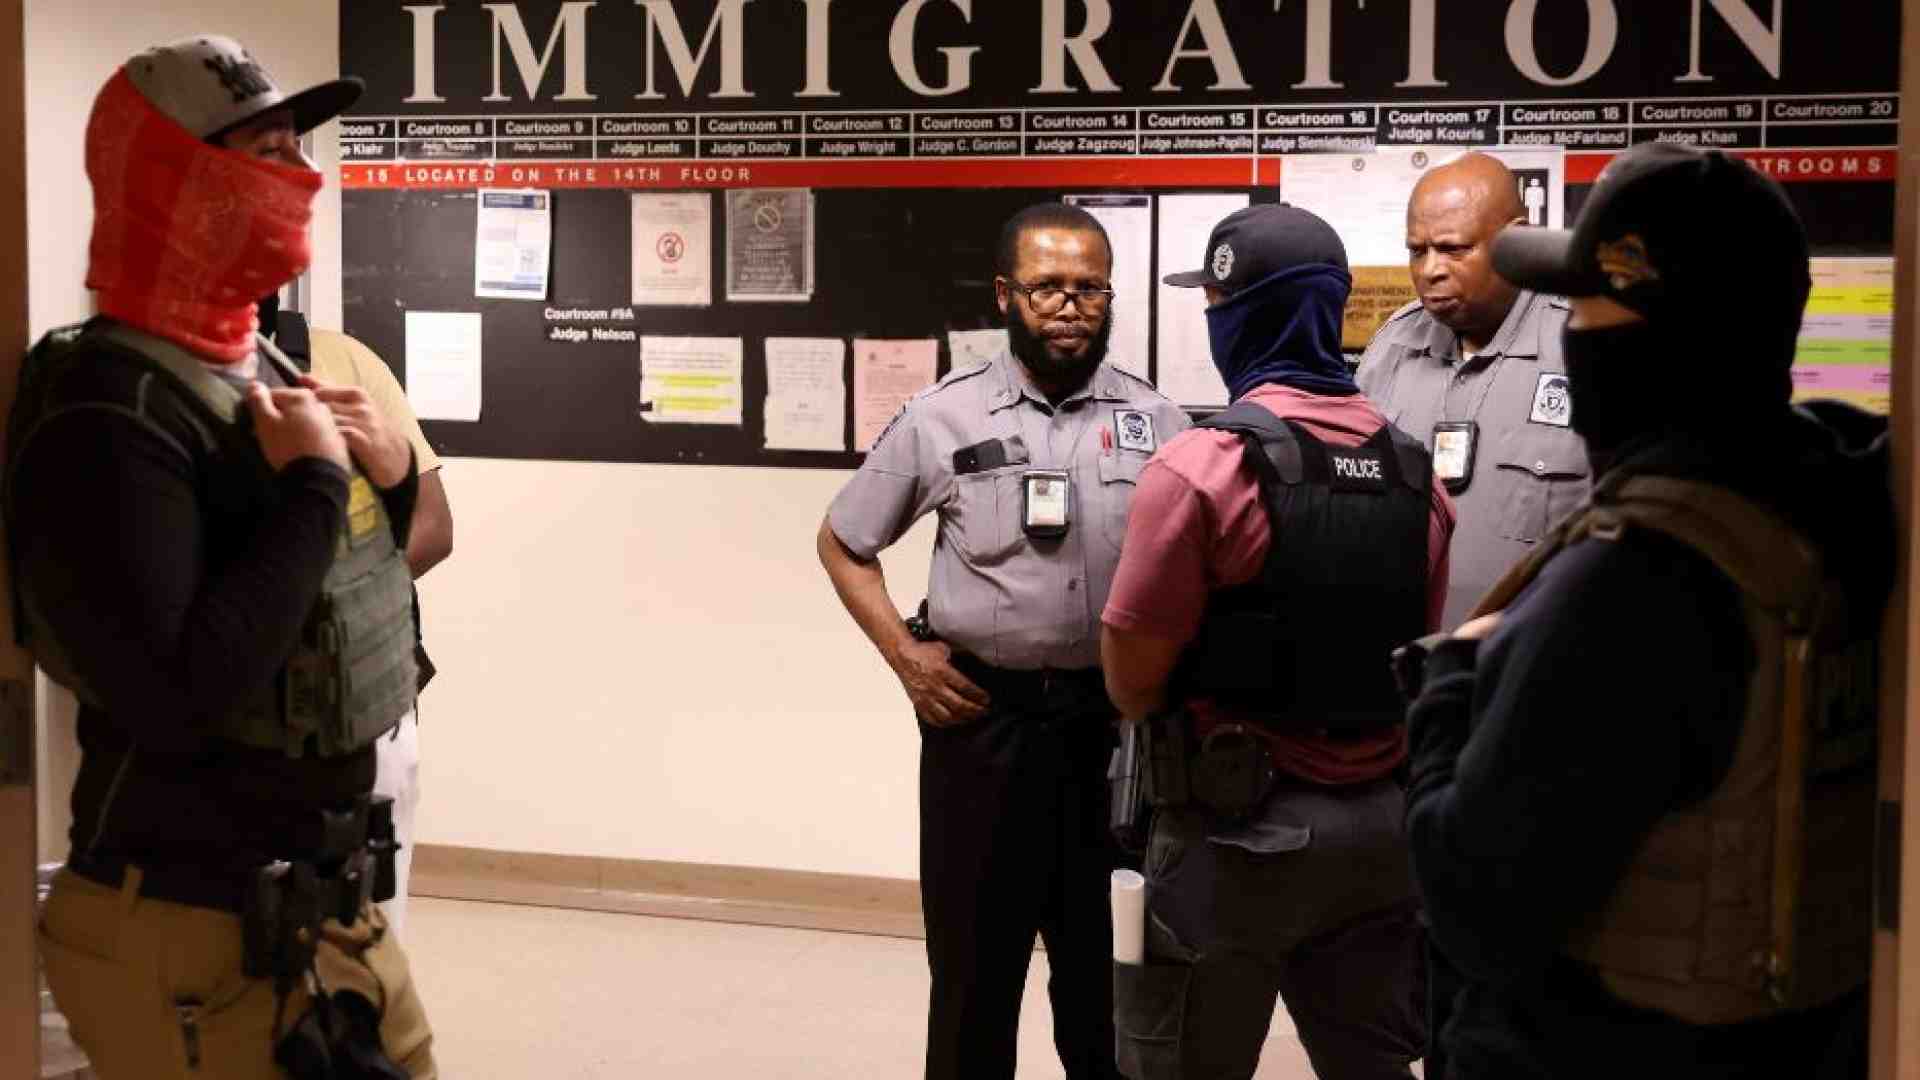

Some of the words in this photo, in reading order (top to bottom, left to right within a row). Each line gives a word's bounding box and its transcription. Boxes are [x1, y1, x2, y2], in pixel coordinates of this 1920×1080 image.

[402, 0, 1785, 105] IMMIGRATION
[1388, 110, 1470, 124] Courtroom
[1475, 108, 1492, 122] 17
[1512, 108, 1597, 122] Courtroom
[1602, 106, 1621, 121] 18
[1641, 105, 1728, 120] Courtroom
[1735, 104, 1753, 119] 19
[1773, 102, 1864, 117] Courtroom
[1869, 100, 1892, 115] 20
[603, 120, 670, 133] Courtroom
[674, 119, 689, 132] 10
[708, 119, 776, 132] Courtroom
[783, 119, 793, 131] 11
[812, 118, 884, 131] Courtroom
[888, 118, 903, 131] 12
[921, 116, 993, 130] Courtroom
[999, 115, 1015, 129] 13
[1032, 115, 1107, 129] Courtroom
[1112, 114, 1128, 127] 14
[1147, 113, 1224, 127] Courtroom
[1229, 112, 1246, 126] 15
[1265, 111, 1345, 126] Courtroom
[1349, 111, 1367, 125] 16
[378, 121, 387, 136] 7
[407, 122, 470, 136] Courtroom
[475, 122, 484, 135] 8
[505, 121, 571, 135] Courtroom
[575, 120, 584, 134] 9
[1388, 127, 1432, 142] Judge
[1436, 127, 1485, 140] Kouris
[1510, 130, 1551, 145] Judge
[1554, 128, 1625, 144] McFarland
[1655, 131, 1698, 144] Judge
[1701, 129, 1738, 143] Khan
[611, 142, 645, 155] Judge
[711, 142, 746, 155] Judge
[820, 142, 856, 155] Judge
[858, 141, 896, 155] Wright
[919, 139, 954, 153] Judge
[1035, 138, 1074, 152] Judge
[405, 168, 495, 182] LOCATED
[512, 168, 540, 182] ON
[556, 168, 596, 181] THE
[614, 167, 660, 181] 14TH
[681, 167, 751, 181] FLOOR
[544, 307, 608, 321] Courtroom
[550, 326, 589, 343] Judge
[592, 326, 636, 341] Nelson
[1333, 456, 1382, 480] POLICE
